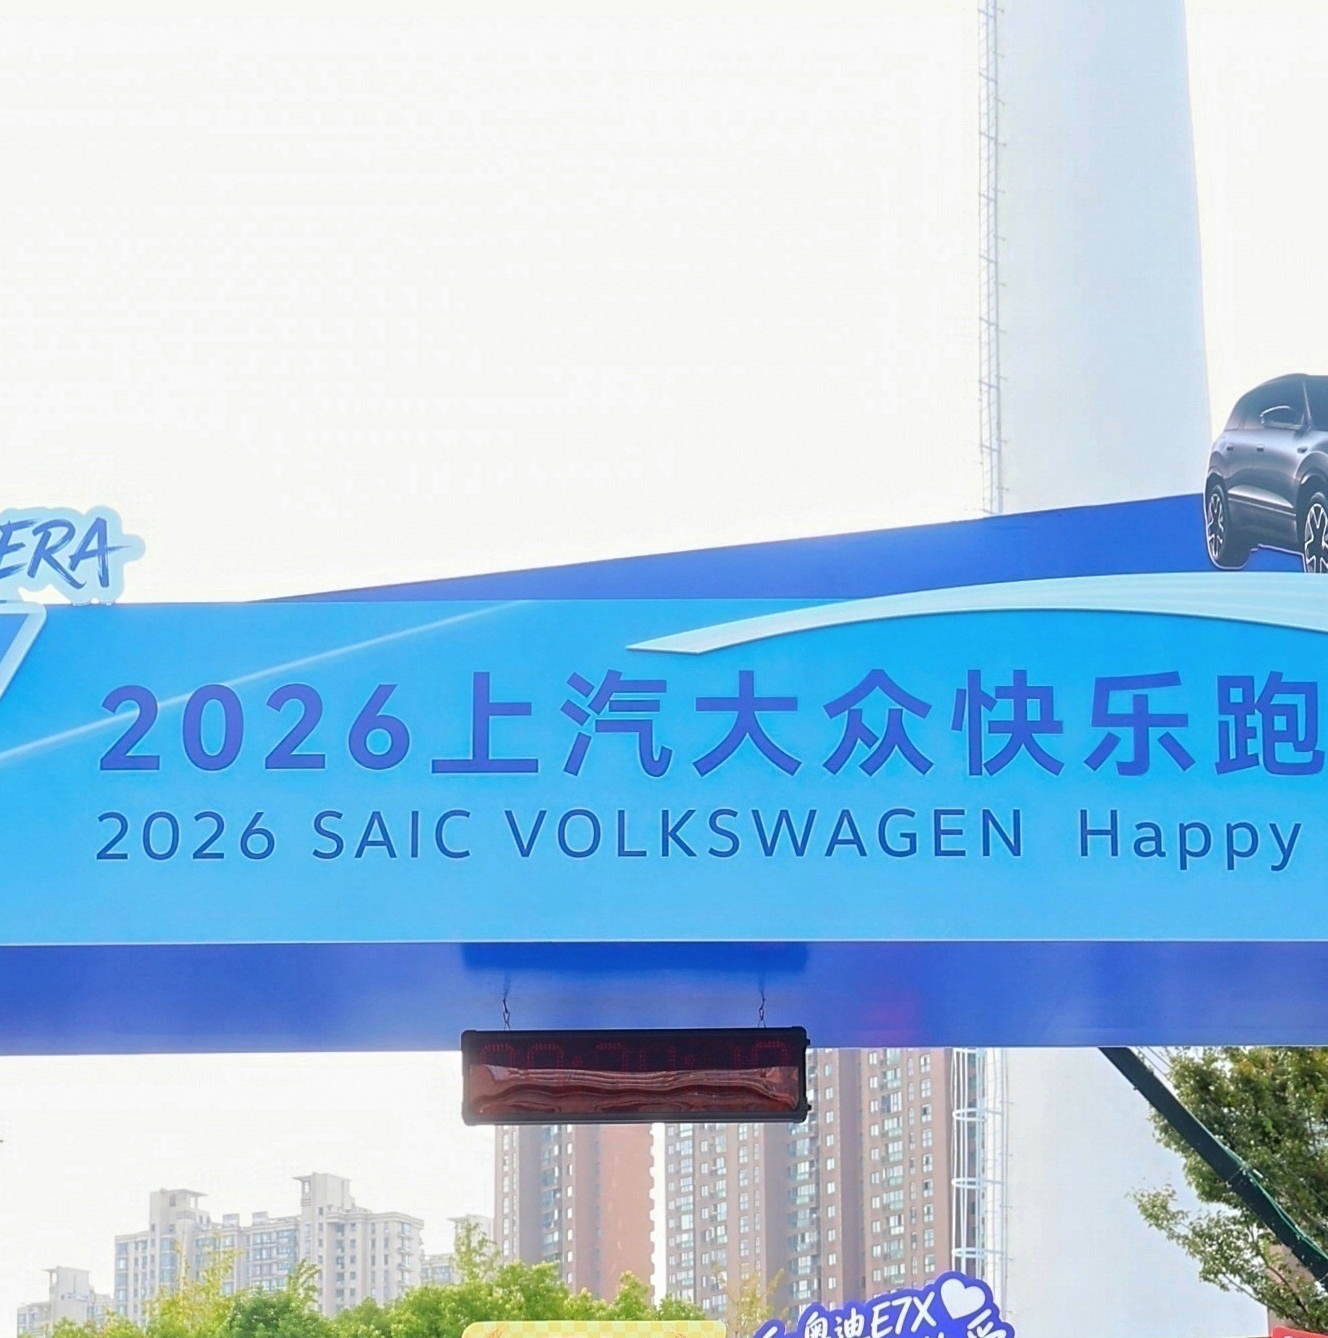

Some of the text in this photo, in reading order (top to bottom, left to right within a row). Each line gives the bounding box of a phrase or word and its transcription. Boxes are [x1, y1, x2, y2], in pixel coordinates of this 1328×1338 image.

[99, 666, 1328, 783] 2026上汽大众快乐跑
[95, 810, 276, 863] 2026
[310, 808, 472, 861] SAIC
[504, 806, 1025, 861] VOLKSWAGEN
[1078, 809, 1303, 872] Happy
